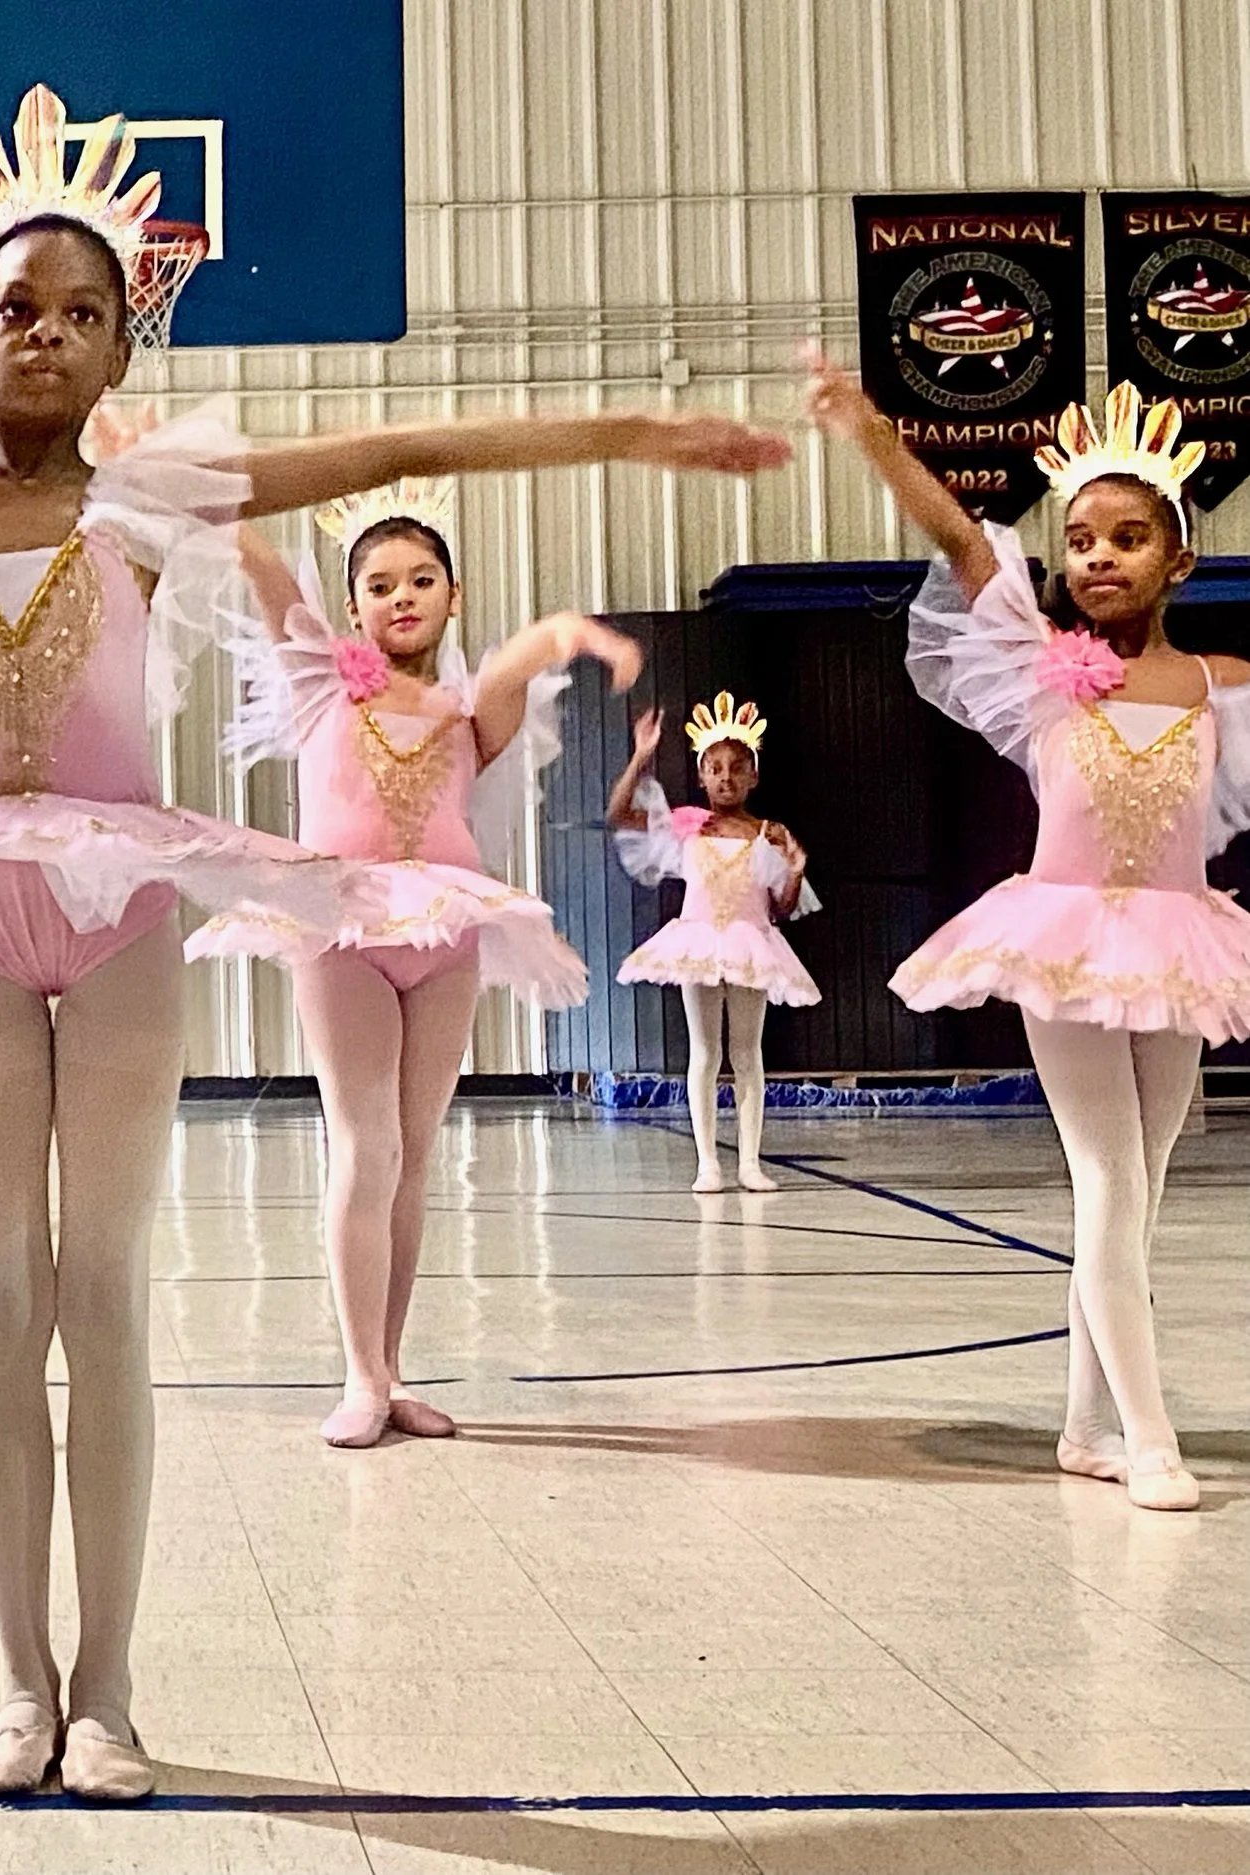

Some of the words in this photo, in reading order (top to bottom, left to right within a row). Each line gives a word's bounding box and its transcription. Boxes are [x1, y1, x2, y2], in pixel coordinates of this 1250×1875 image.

[871, 221, 1071, 250] NATIONAL
[888, 267, 930, 316] THE
[929, 251, 1052, 315] AMERICAN
[929, 335, 966, 350] CHEER
[978, 333, 1016, 350] DANCE
[899, 354, 1047, 412] CHAMPIONSHIPS
[878, 413, 1056, 443] HAMPION
[945, 469, 1009, 490] 2022
